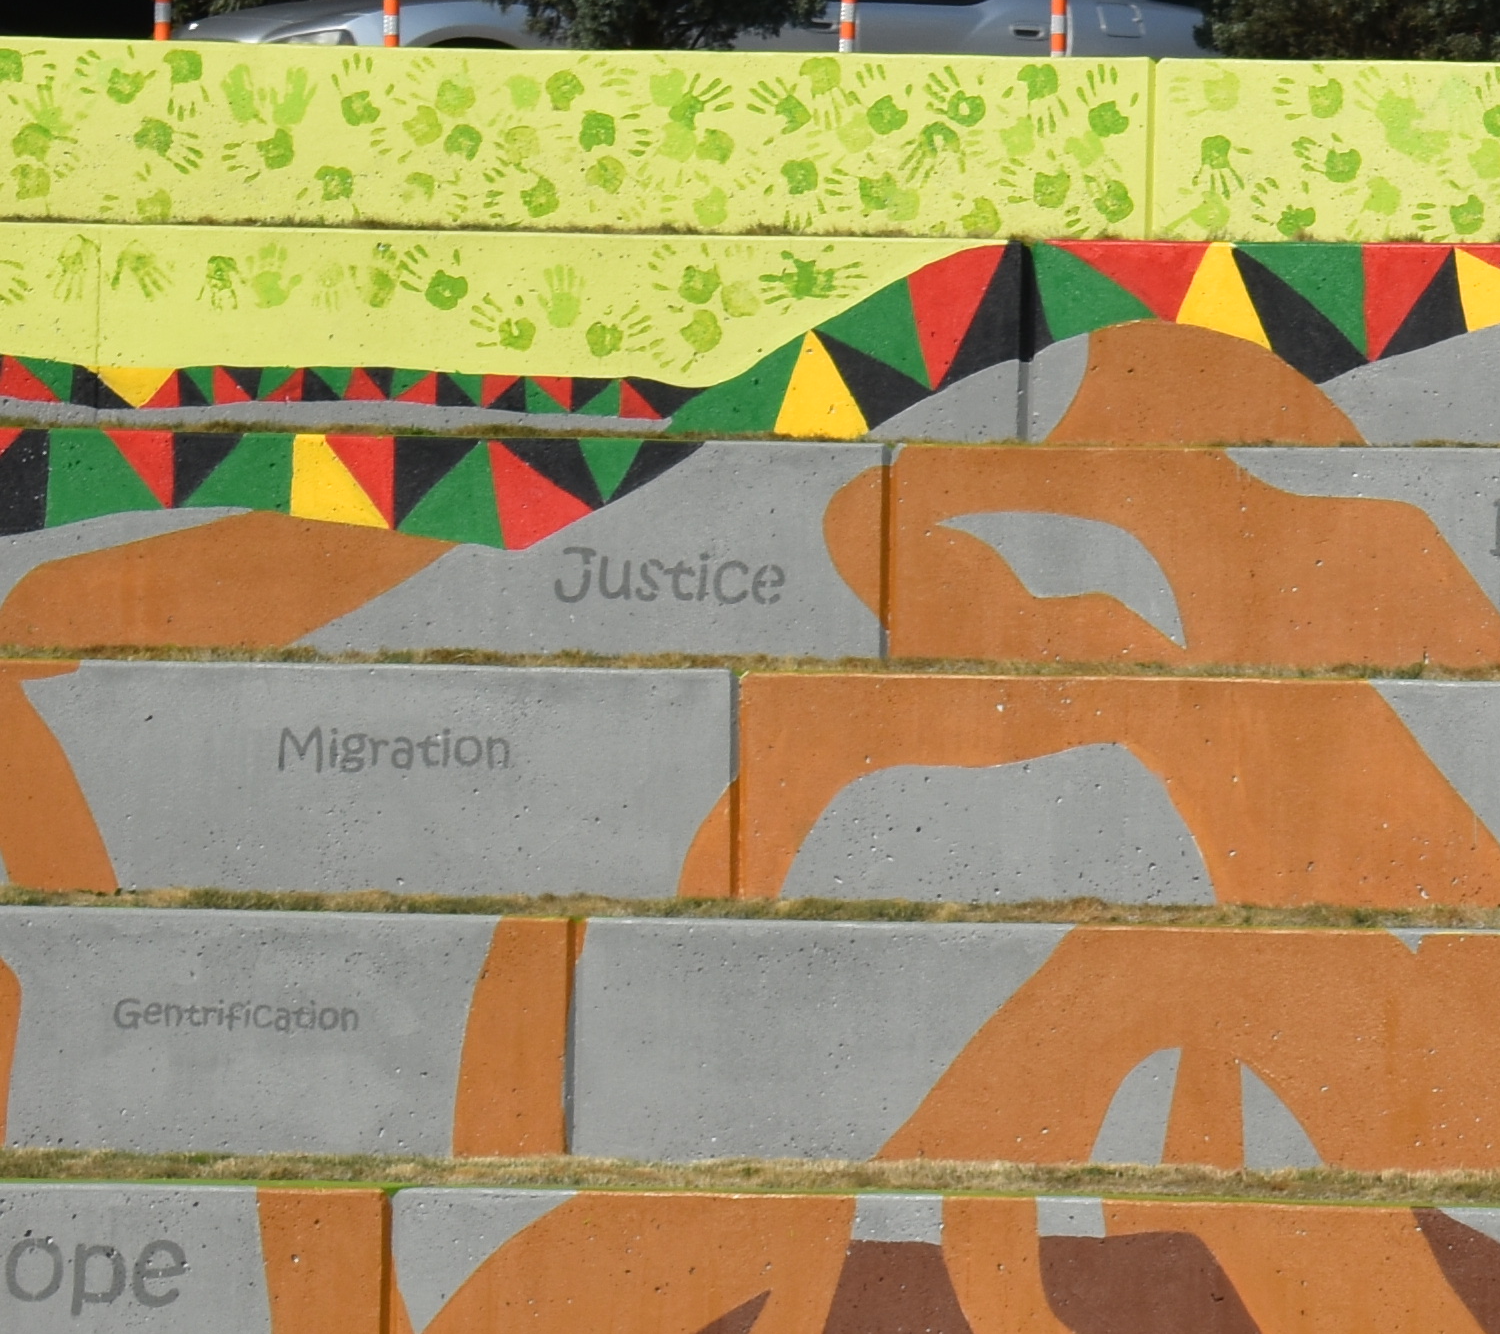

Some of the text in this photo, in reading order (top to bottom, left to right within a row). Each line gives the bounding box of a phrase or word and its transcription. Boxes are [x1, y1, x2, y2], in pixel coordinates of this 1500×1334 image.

[554, 546, 786, 607] Justice
[277, 725, 512, 773] Migration
[113, 997, 360, 1033] Gentrification
